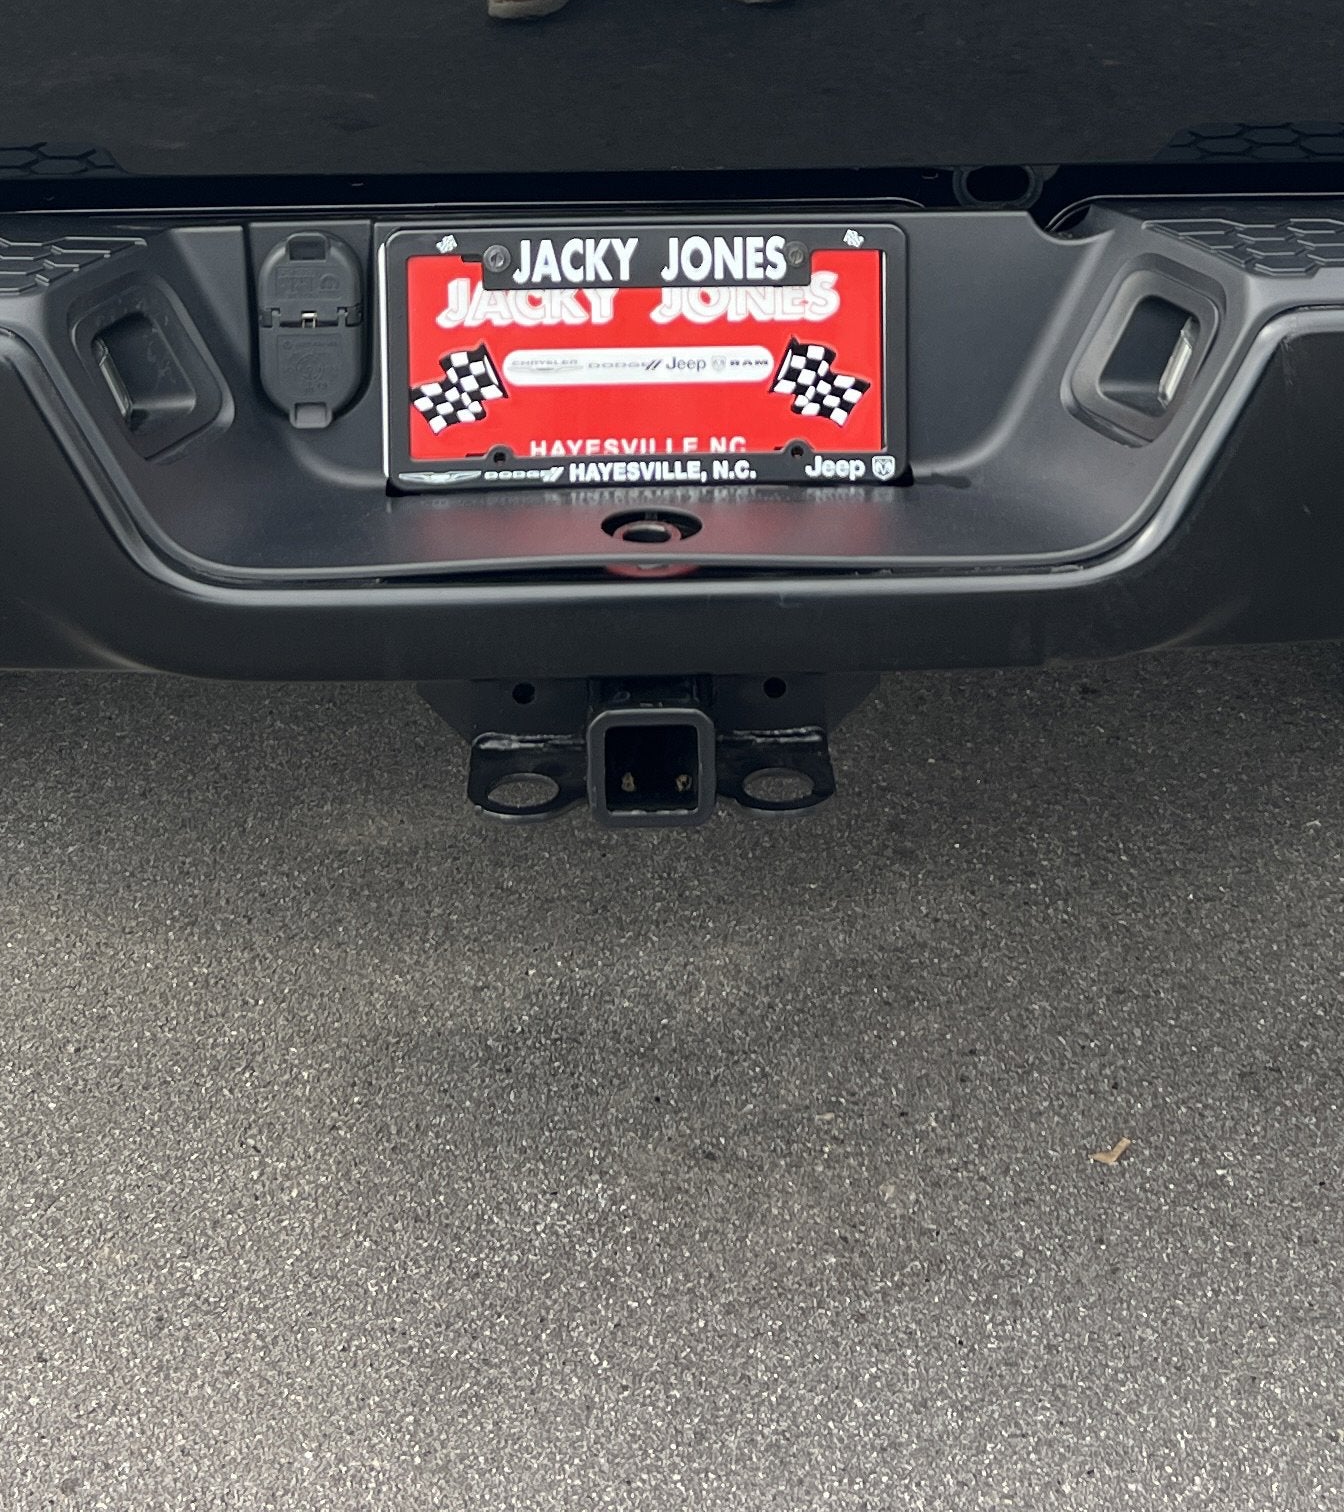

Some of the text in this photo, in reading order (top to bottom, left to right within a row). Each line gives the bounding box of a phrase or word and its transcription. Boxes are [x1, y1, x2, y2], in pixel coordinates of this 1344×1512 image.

[513, 234, 788, 285] JACKY JONES
[436, 271, 841, 329] JACKY JONES
[665, 356, 707, 371] Jeep
[568, 459, 708, 484] HAYESVILLE,
[712, 458, 758, 481] N.C.
[805, 455, 866, 481] Jeep
